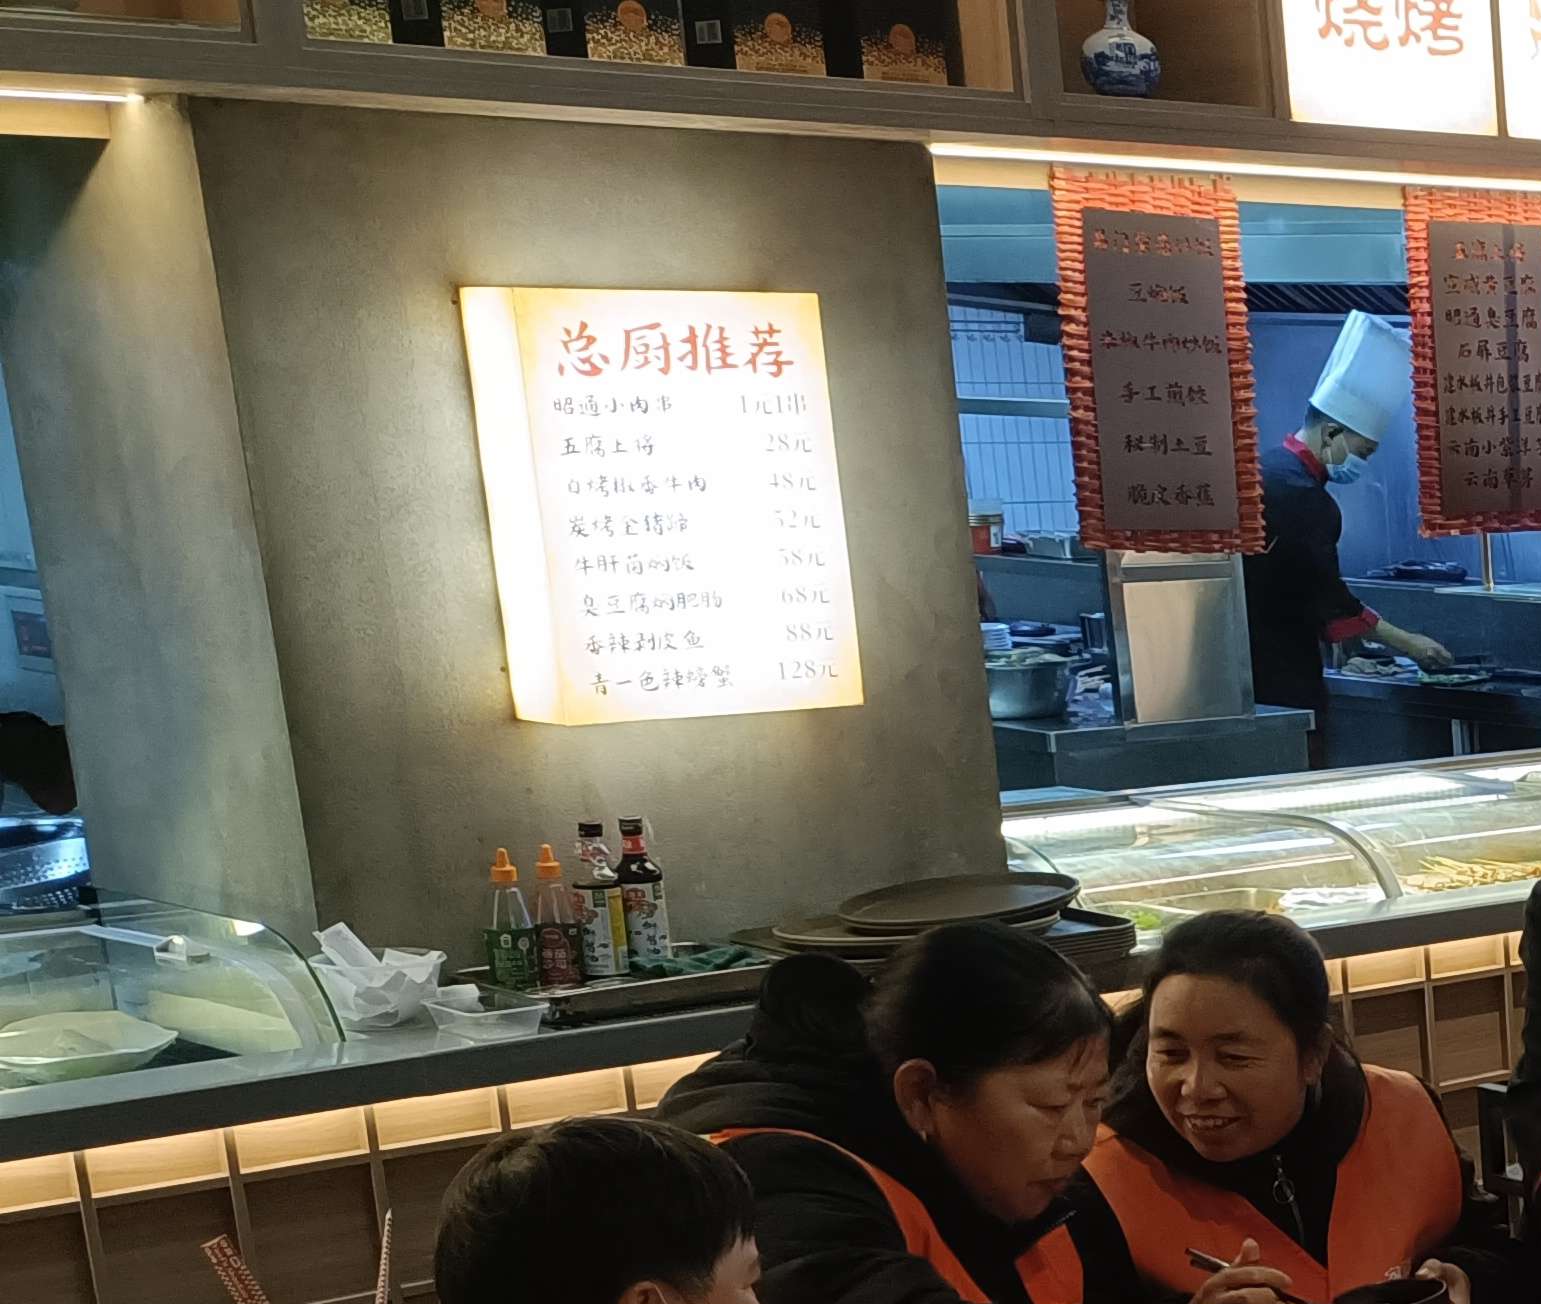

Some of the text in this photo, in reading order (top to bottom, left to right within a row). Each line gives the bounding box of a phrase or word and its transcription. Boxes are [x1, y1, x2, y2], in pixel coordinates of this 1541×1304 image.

[558, 321, 795, 378] 总厨推荐
[778, 659, 840, 680] 128元
